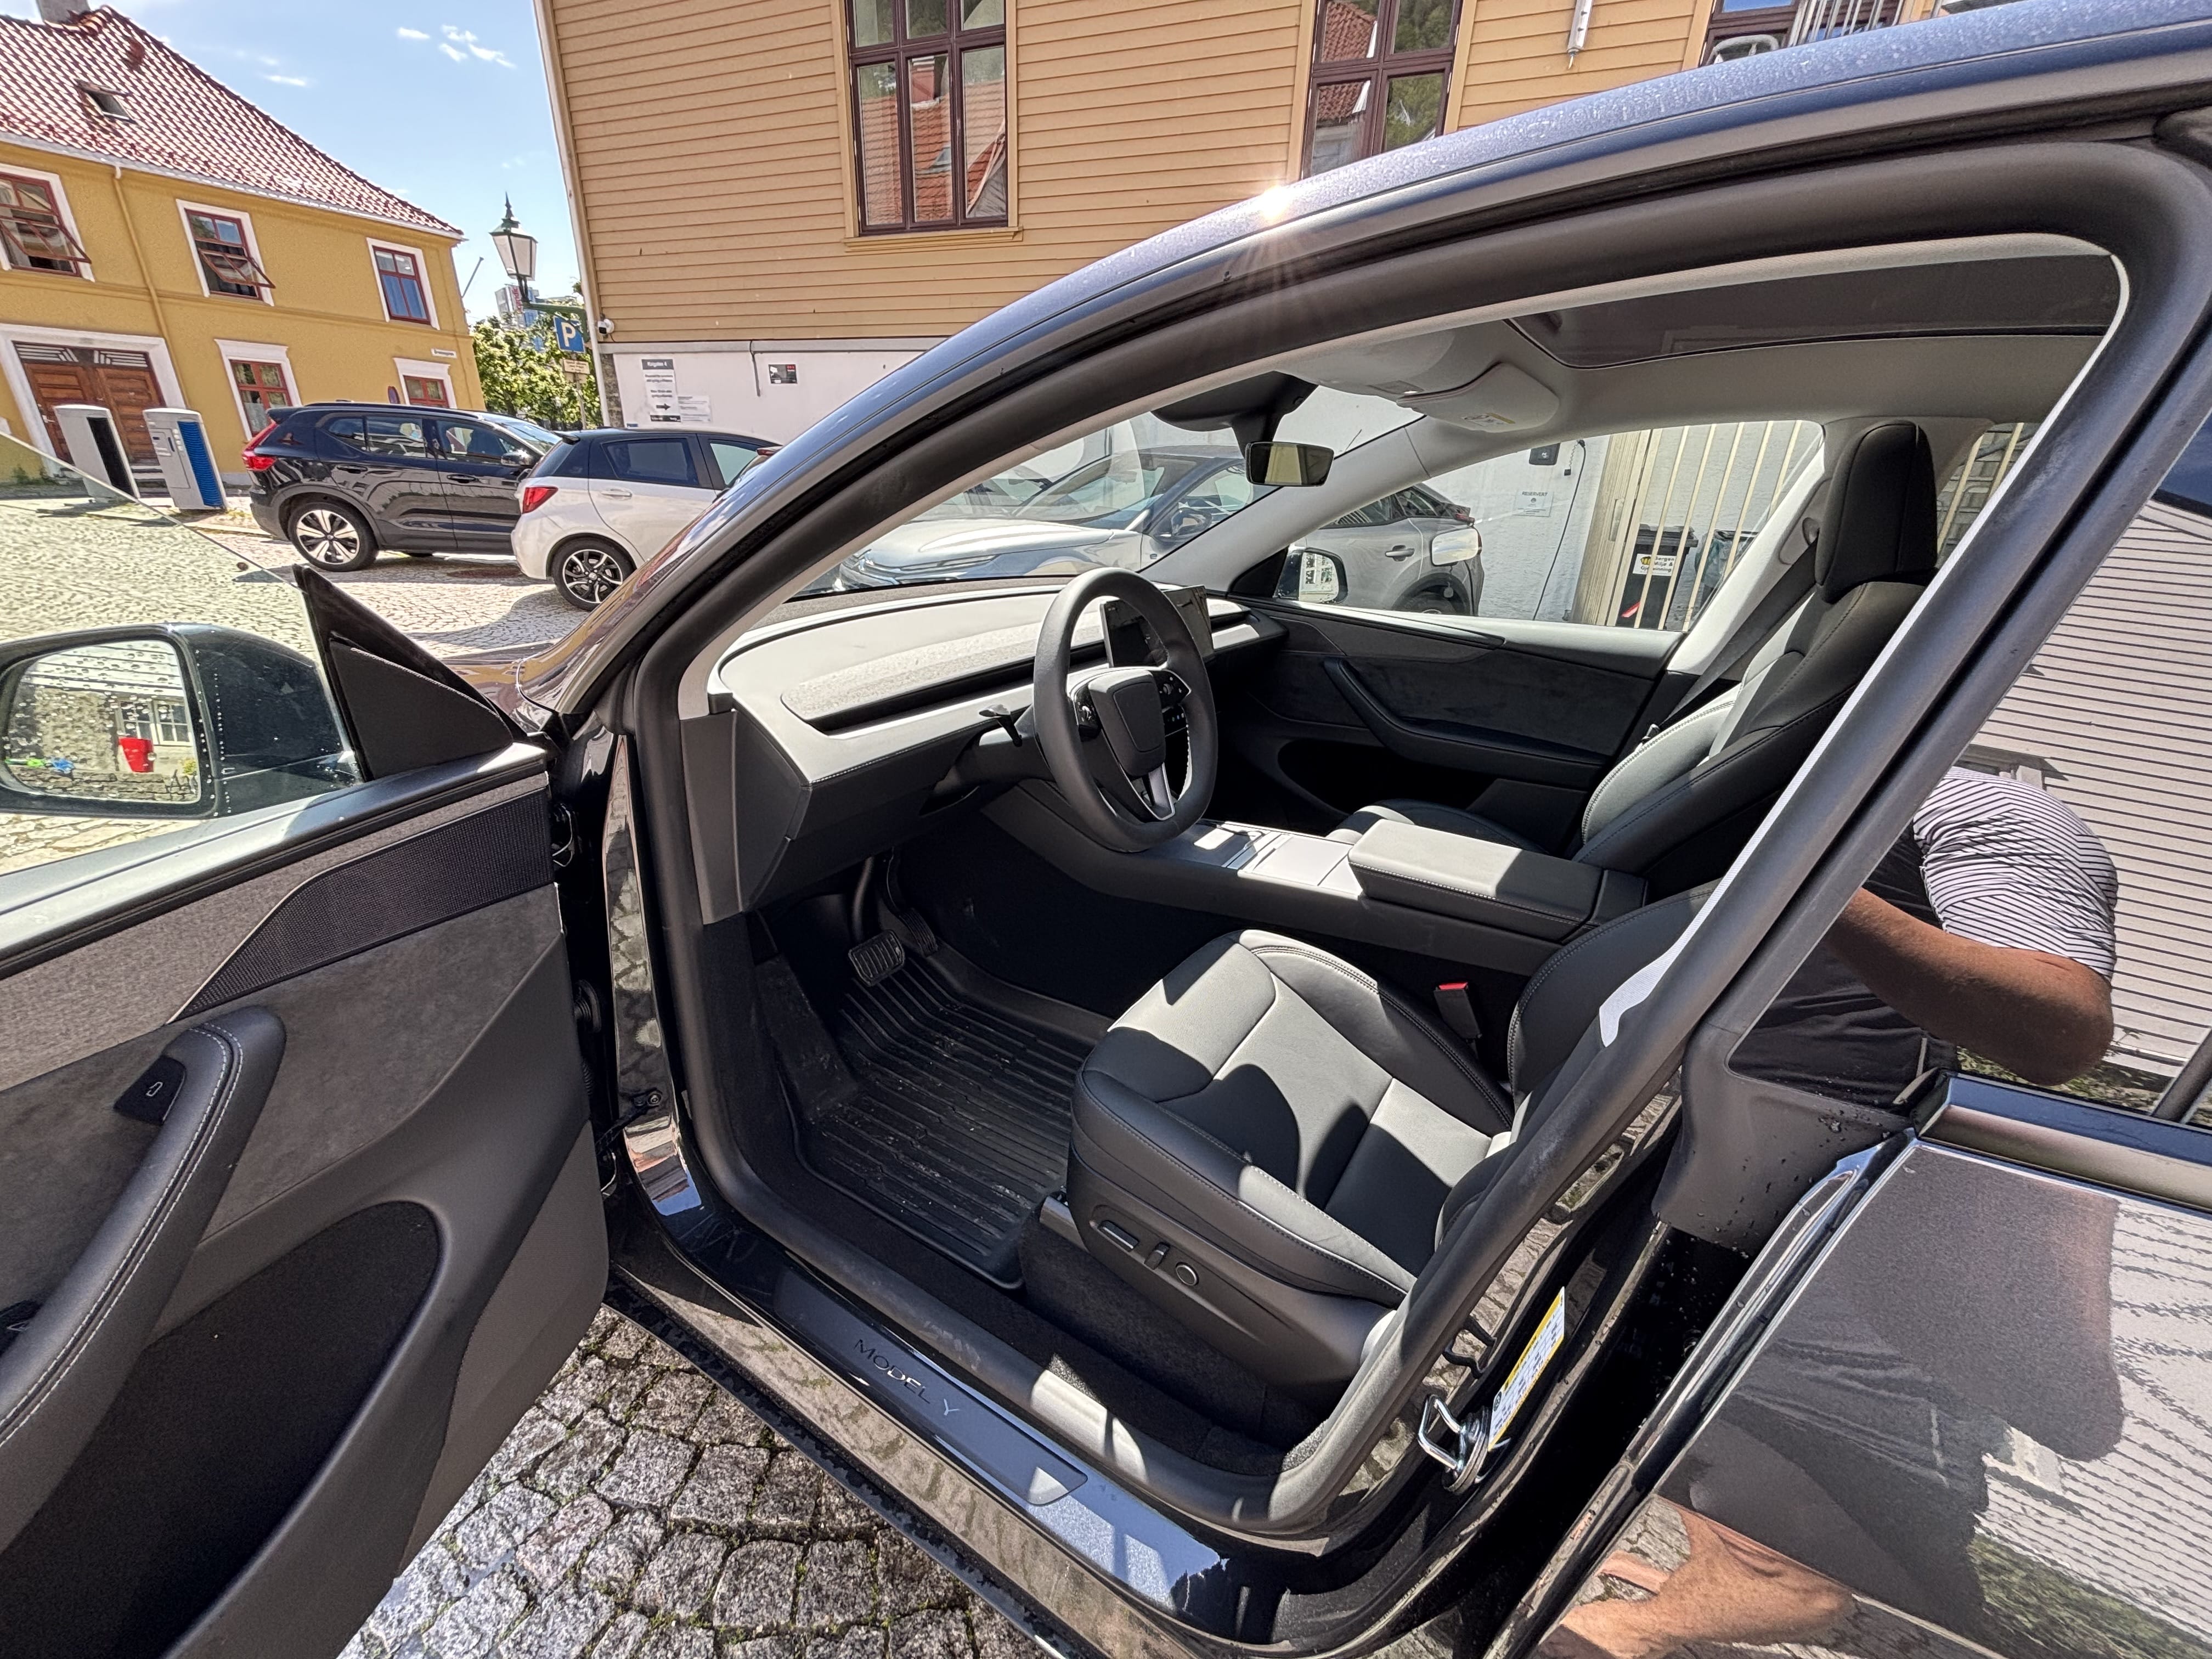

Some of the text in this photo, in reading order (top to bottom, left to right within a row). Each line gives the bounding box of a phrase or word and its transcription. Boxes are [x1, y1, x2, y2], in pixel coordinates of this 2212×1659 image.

[561, 321, 575, 347] P
[854, 1339, 960, 1416] MODEL Y
